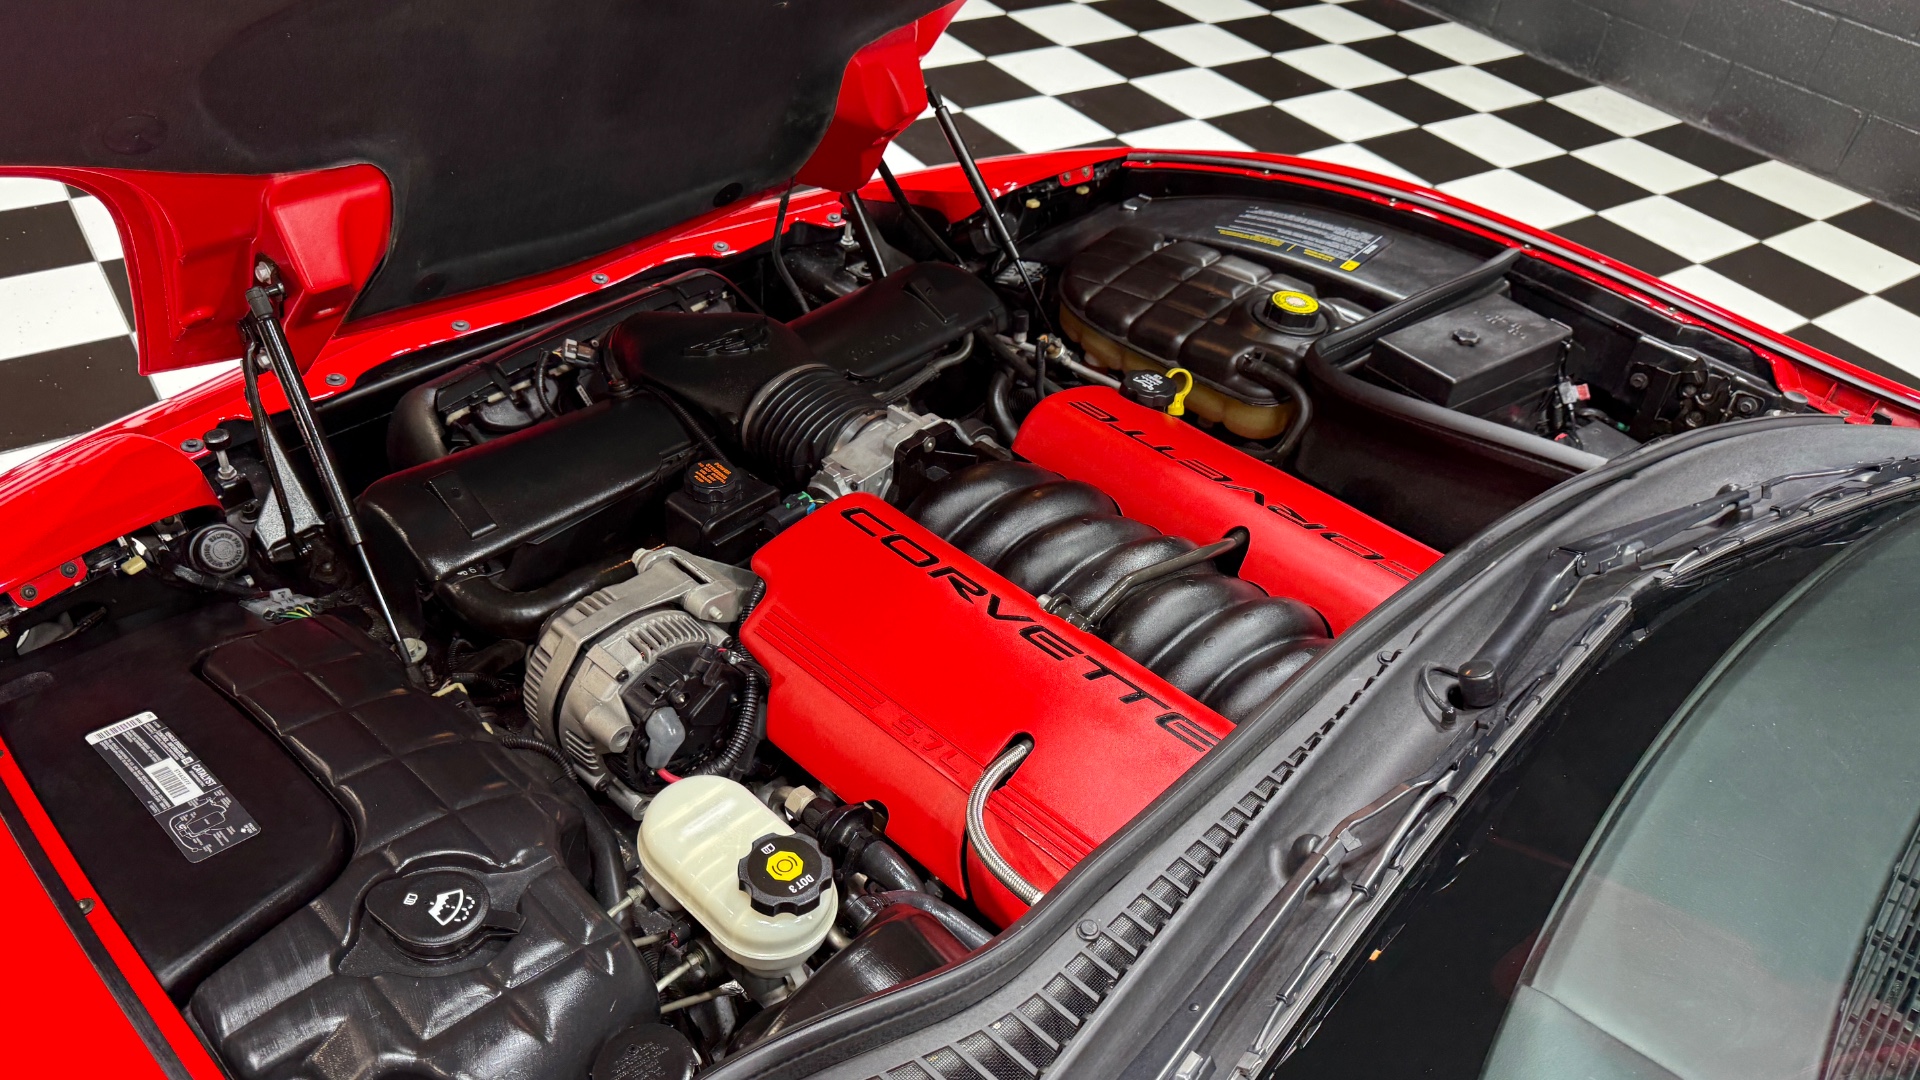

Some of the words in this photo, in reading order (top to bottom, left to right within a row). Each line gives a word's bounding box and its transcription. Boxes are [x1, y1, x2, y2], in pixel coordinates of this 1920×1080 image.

[1067, 402, 1421, 582] CORVETTE
[841, 506, 1222, 752] CORVETTE
[891, 713, 961, 774] 5.7L
[191, 764, 217, 787] CATALYST
[788, 884, 798, 893] 3
[795, 874, 815, 890] DOT
